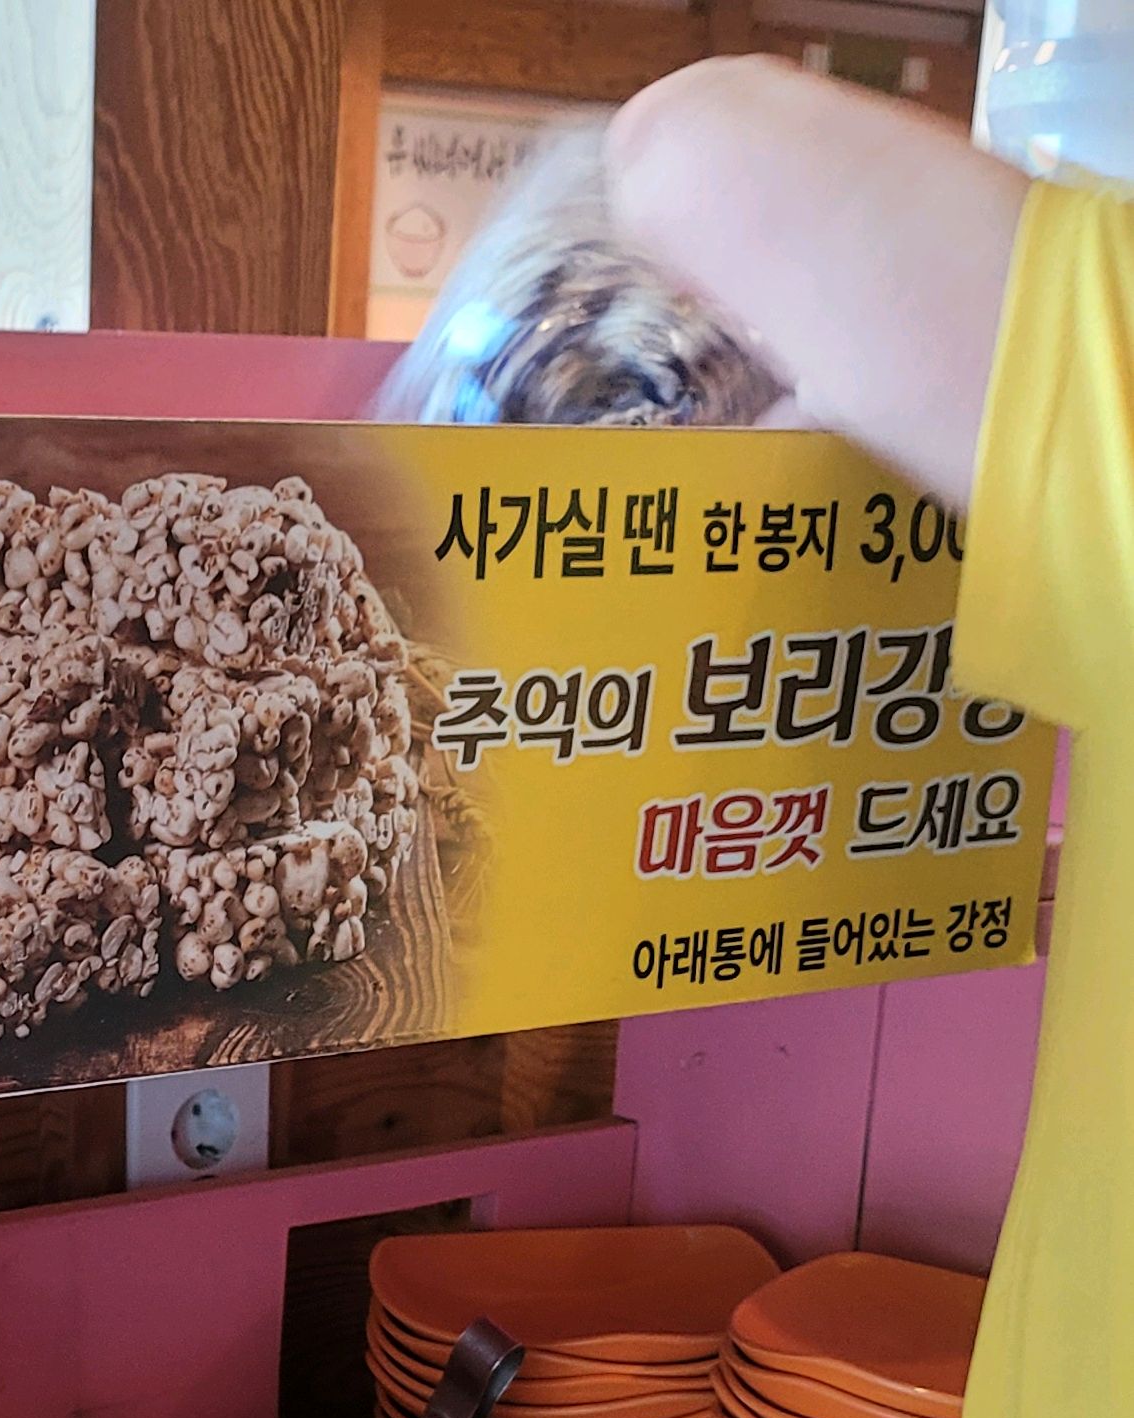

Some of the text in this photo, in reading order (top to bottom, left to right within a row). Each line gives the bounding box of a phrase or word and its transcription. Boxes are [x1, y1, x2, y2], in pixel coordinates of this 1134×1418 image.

[434, 486, 609, 580] 사가실
[622, 486, 679, 576] 땐
[434, 672, 654, 766] 추억의
[637, 774, 1022, 876] 마음껏 드세요
[632, 896, 1014, 990] 아래통에 들어있는 강정
